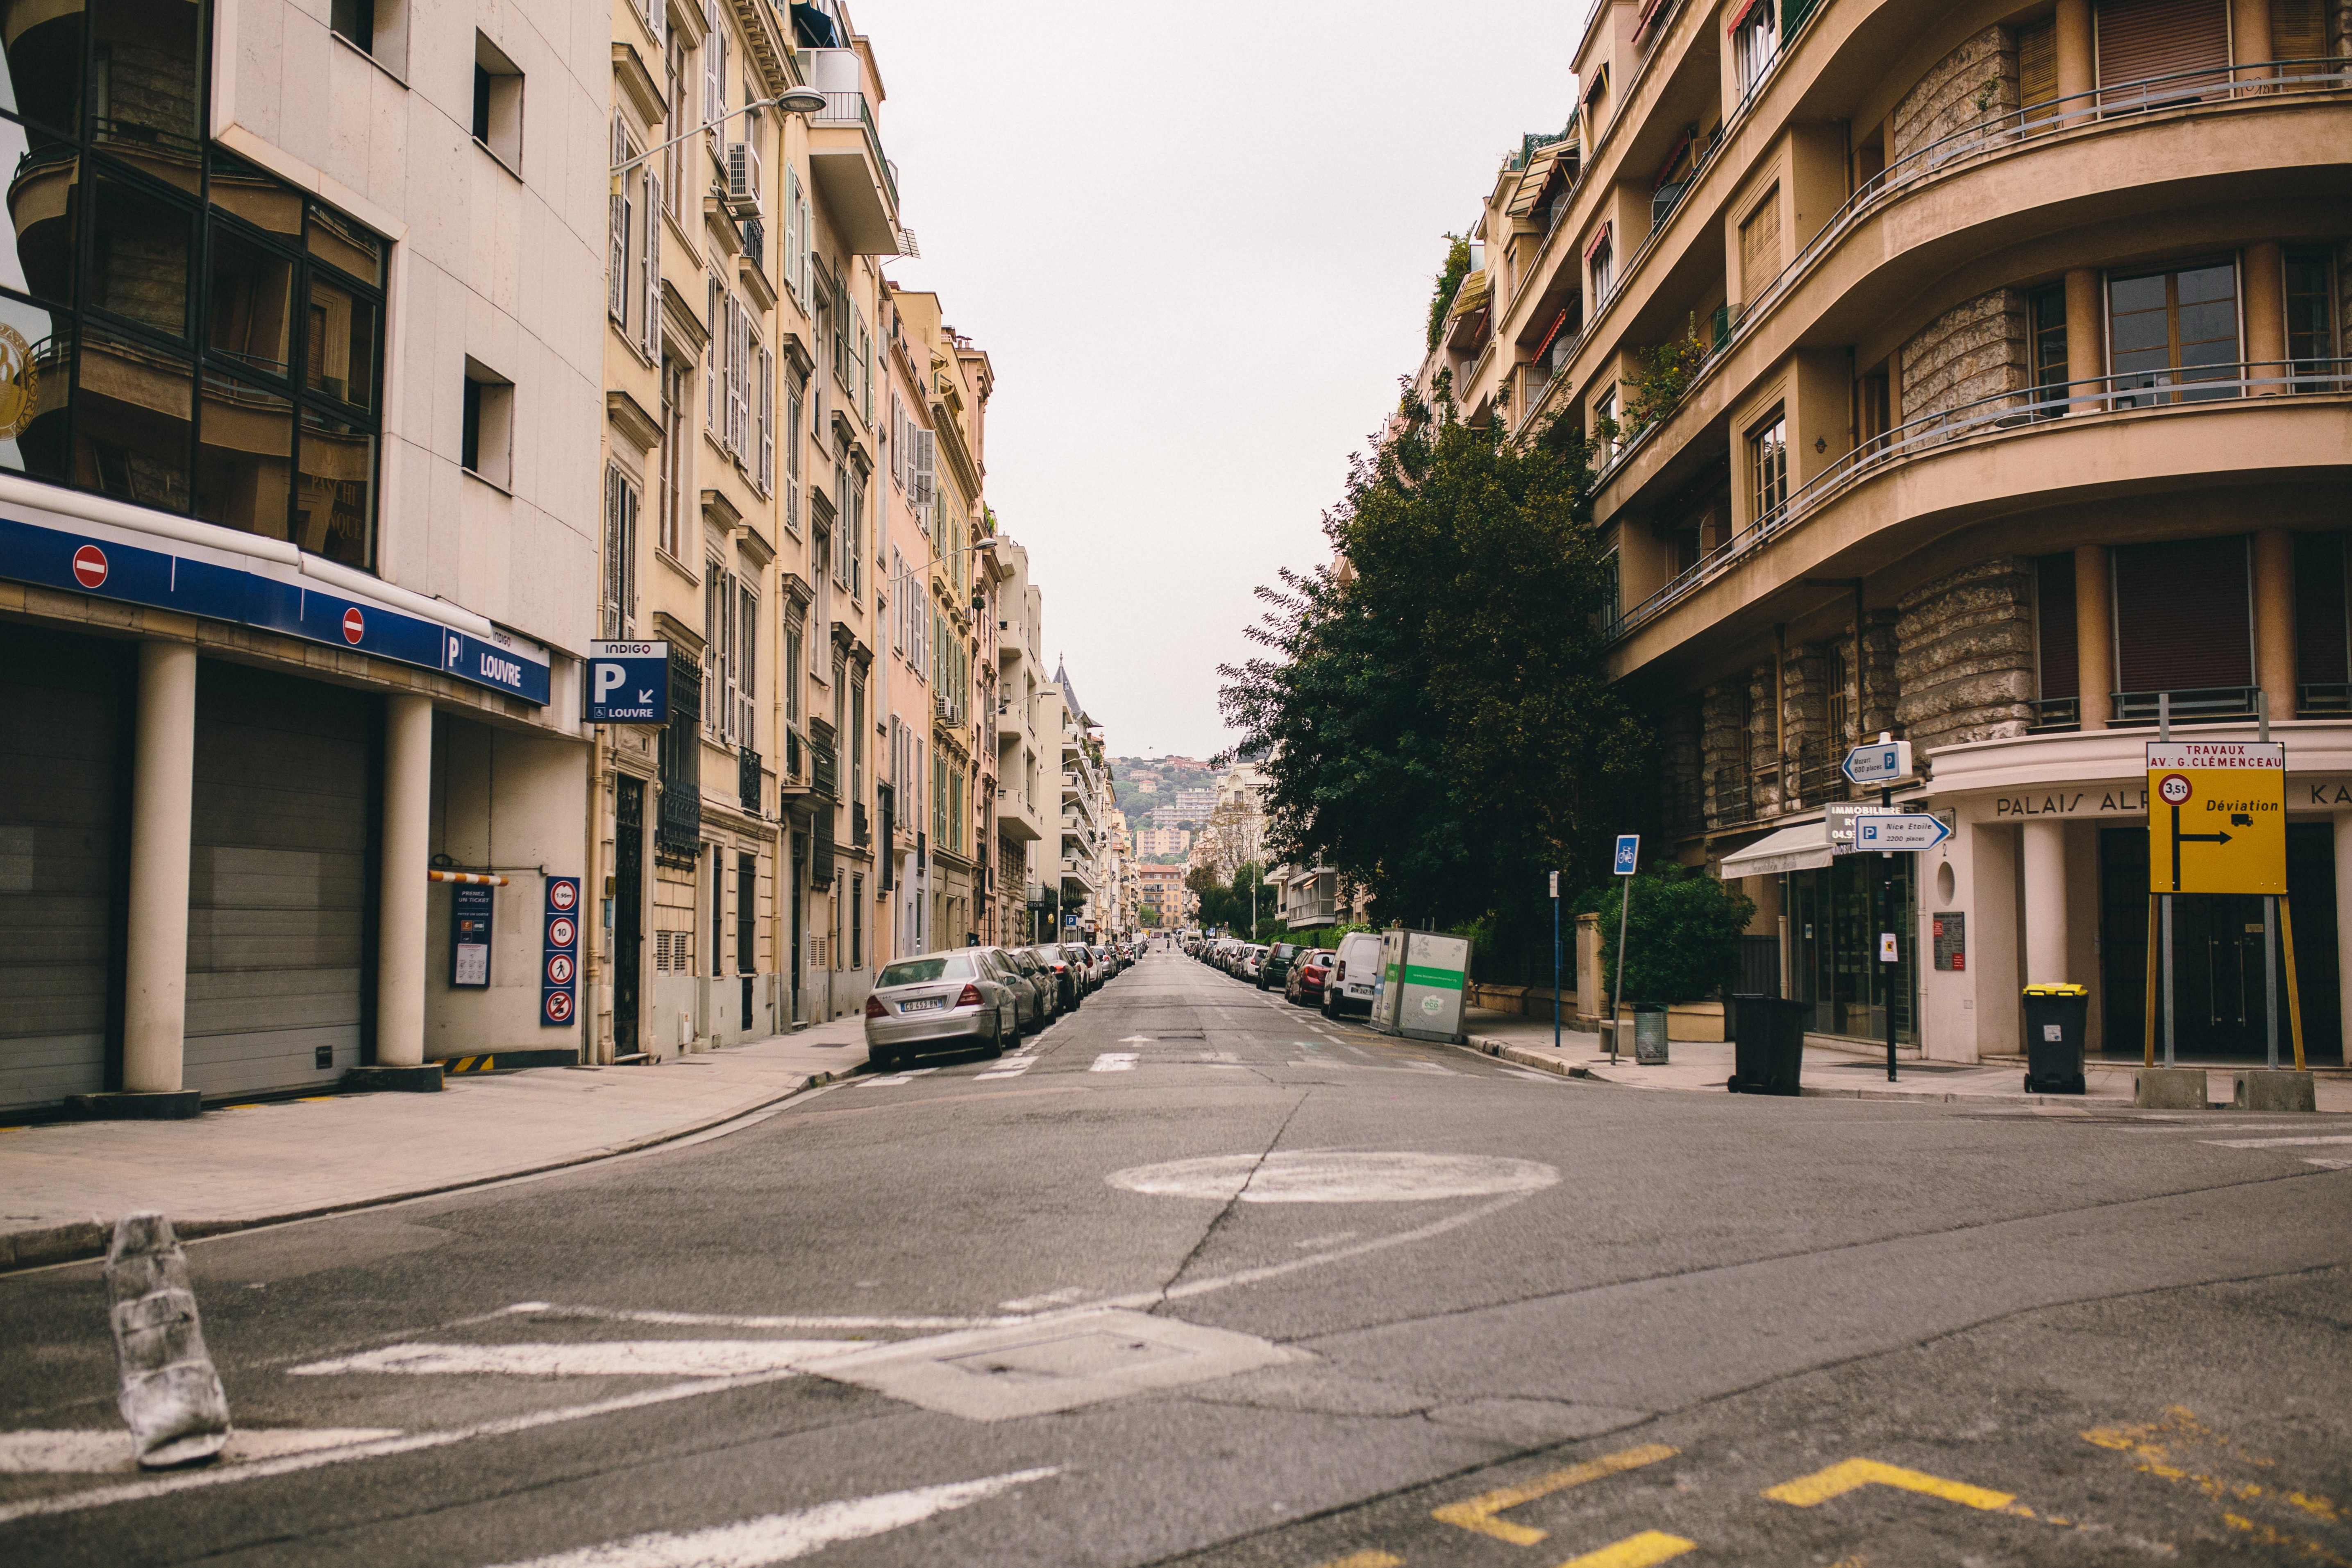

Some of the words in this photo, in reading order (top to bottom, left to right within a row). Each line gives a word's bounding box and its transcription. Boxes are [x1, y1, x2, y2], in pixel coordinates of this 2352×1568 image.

[311, 474, 356, 506] PASCHI
[316, 507, 362, 541] NQUE
[493, 631, 511, 648] INDIGO
[606, 644, 651, 655] INDIGO
[449, 637, 459, 667] P
[481, 653, 521, 688] LOUVRE
[595, 663, 626, 703] P
[608, 708, 654, 717] LOUVRE
[2186, 745, 2245, 755] TRAVAUX
[1854, 757, 1871, 765] Mozart
[1887, 755, 1893, 767] P
[2150, 757, 2171, 767] AV.
[1866, 765, 1882, 774] places
[2165, 783, 2186, 795] 3,5t
[1831, 806, 1901, 815] IMMOBILIRE
[1998, 793, 2084, 816] PALAIS
[2206, 799, 2279, 812] Déviation
[1865, 828, 1875, 839] P
[1943, 843, 1947, 857] 2
[557, 928, 566, 937] 10
